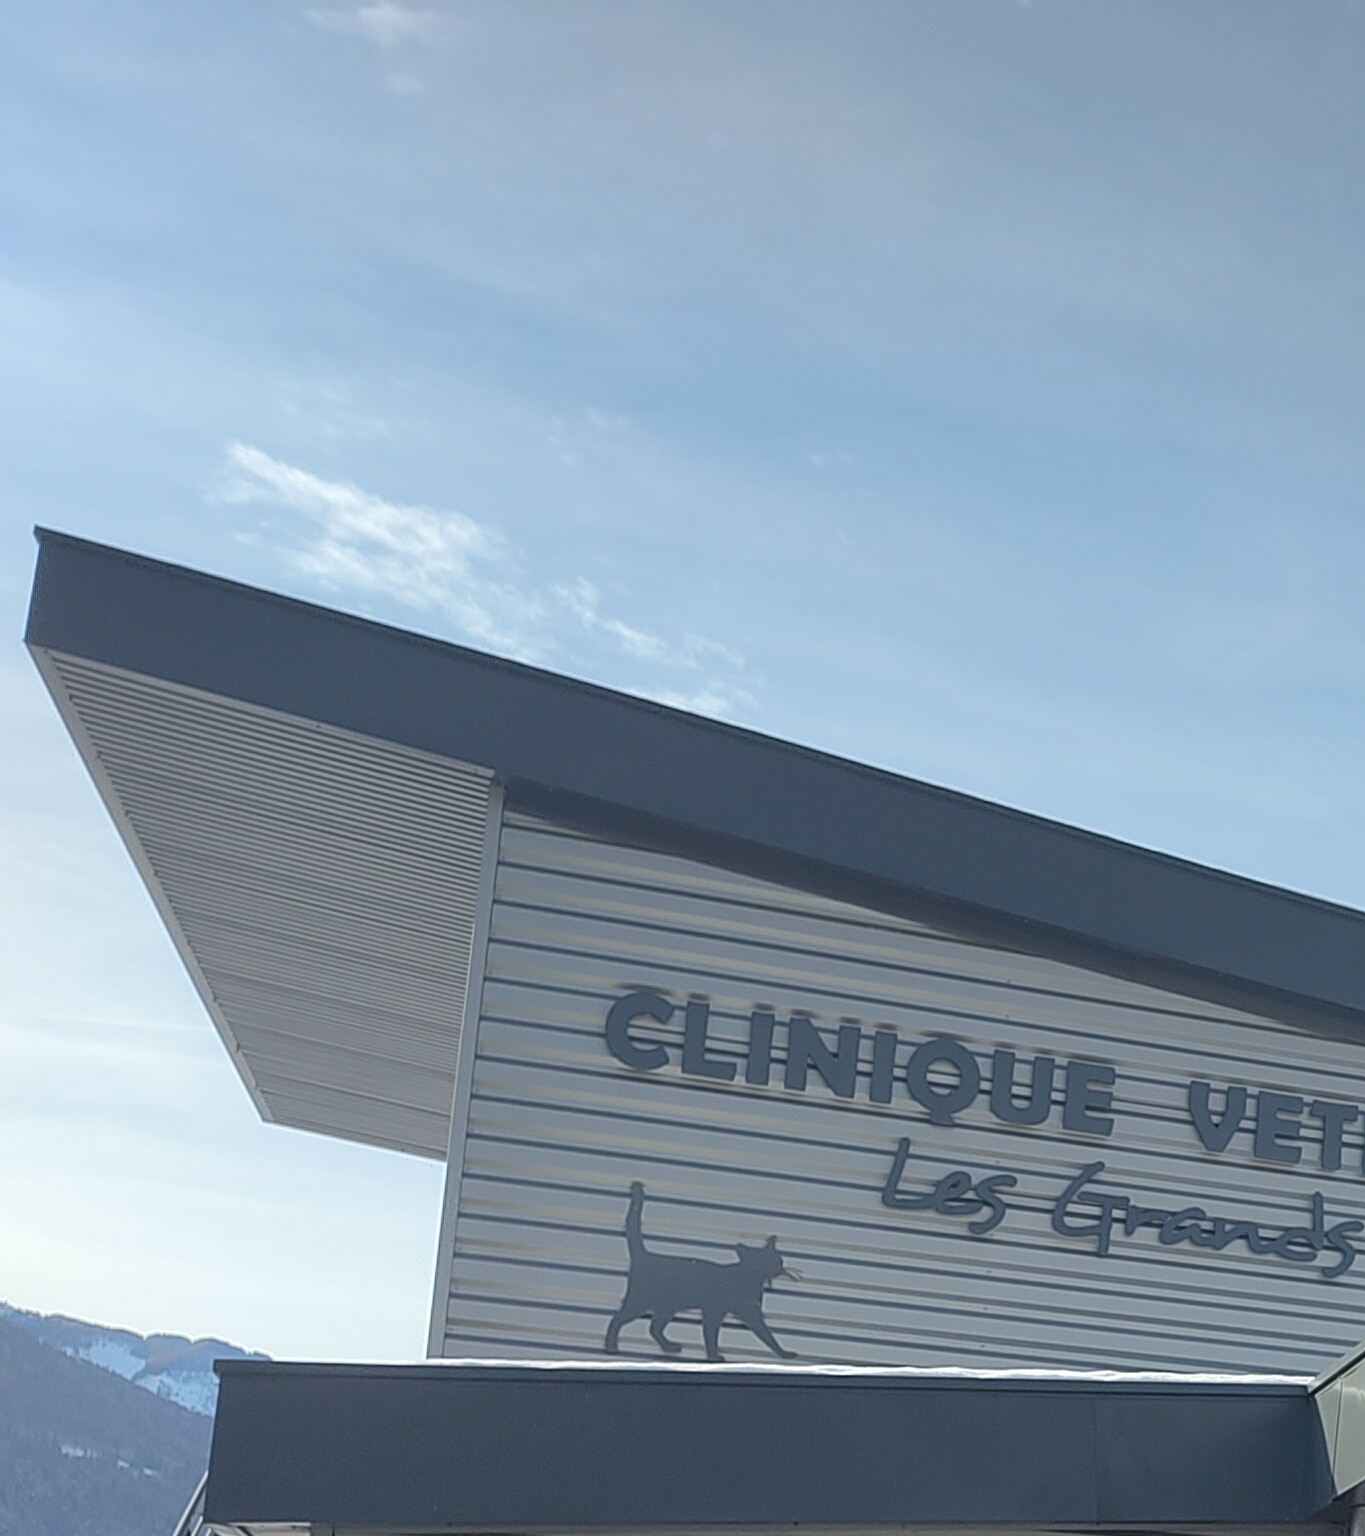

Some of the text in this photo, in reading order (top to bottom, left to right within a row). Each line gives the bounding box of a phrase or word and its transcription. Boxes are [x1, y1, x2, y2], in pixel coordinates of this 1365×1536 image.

[605, 990, 1116, 1136] CLINIQUE
[881, 1137, 1017, 1234] Les
[1051, 1160, 1365, 1278] Grands
